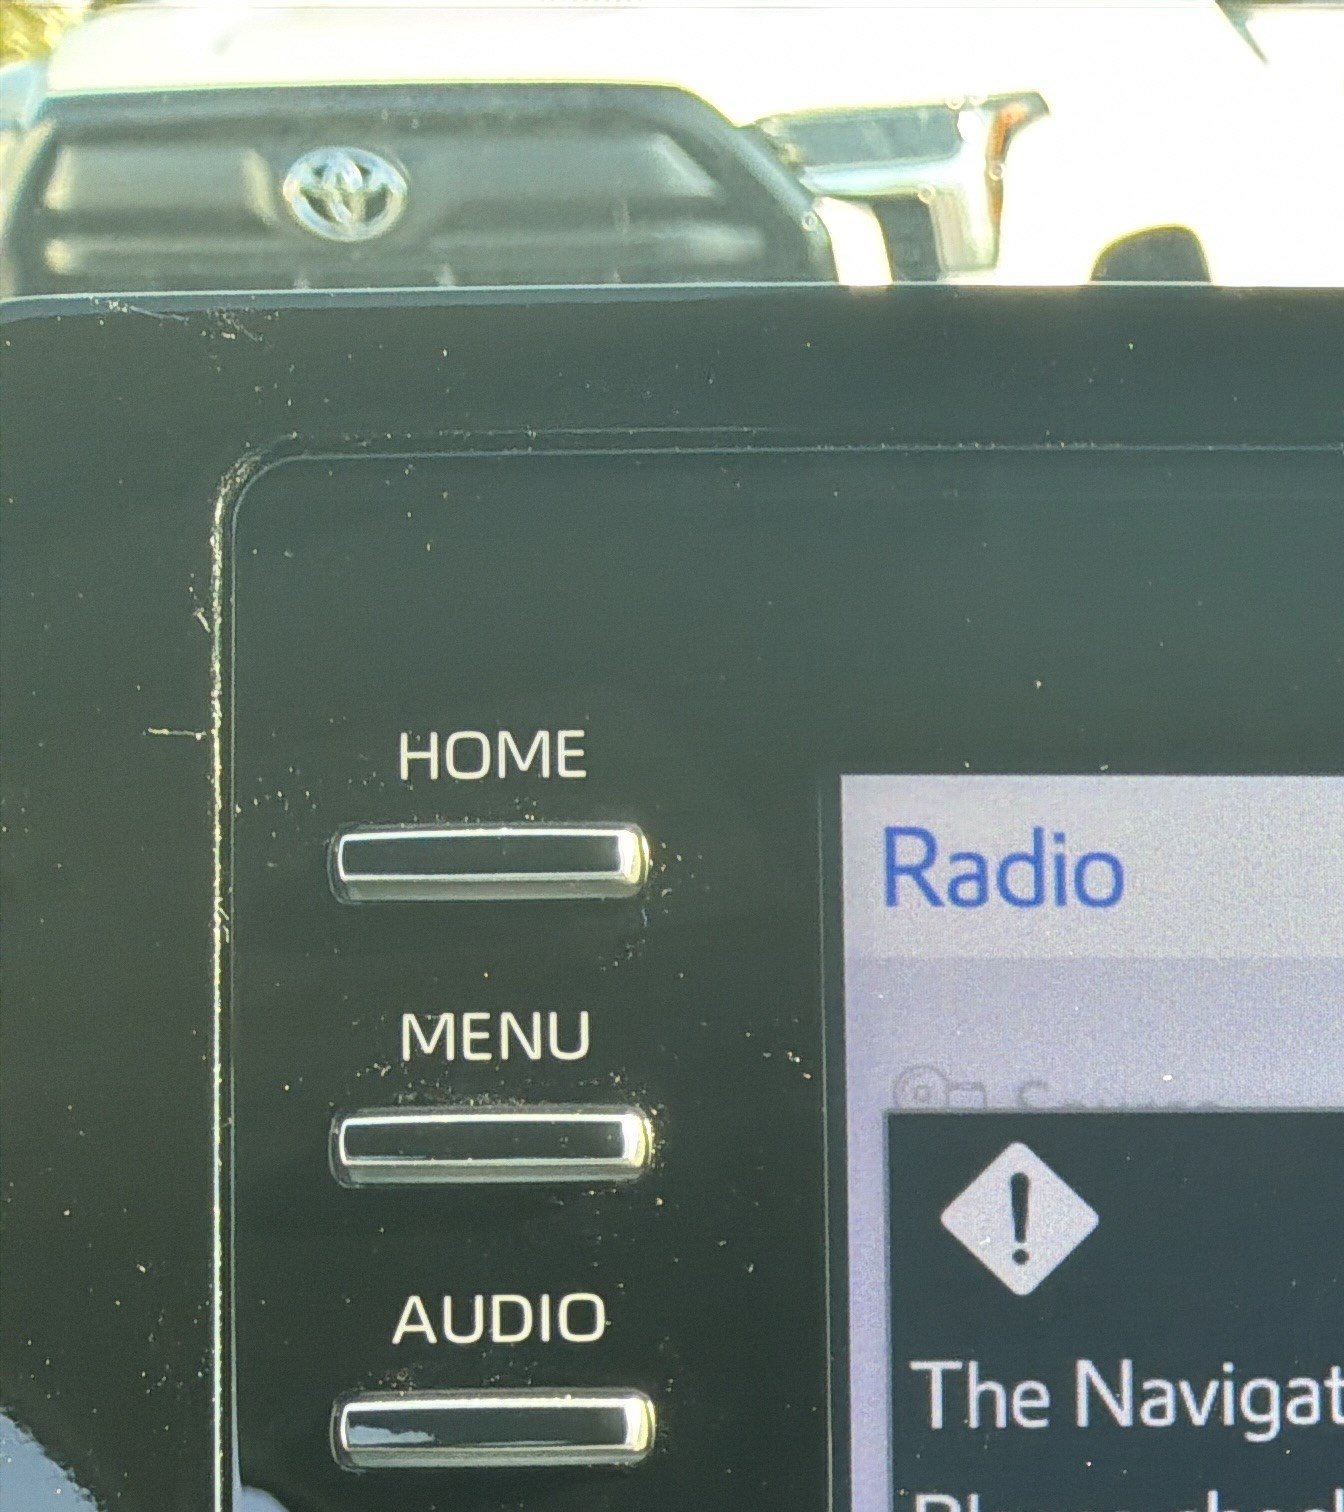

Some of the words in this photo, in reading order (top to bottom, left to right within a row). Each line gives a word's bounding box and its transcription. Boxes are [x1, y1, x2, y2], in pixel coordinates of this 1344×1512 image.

[399, 729, 586, 780] HOME
[883, 826, 1125, 909] Radio
[401, 1011, 590, 1061] MENU
[392, 1292, 607, 1345] AUDIO
[910, 1360, 1050, 1429] The
